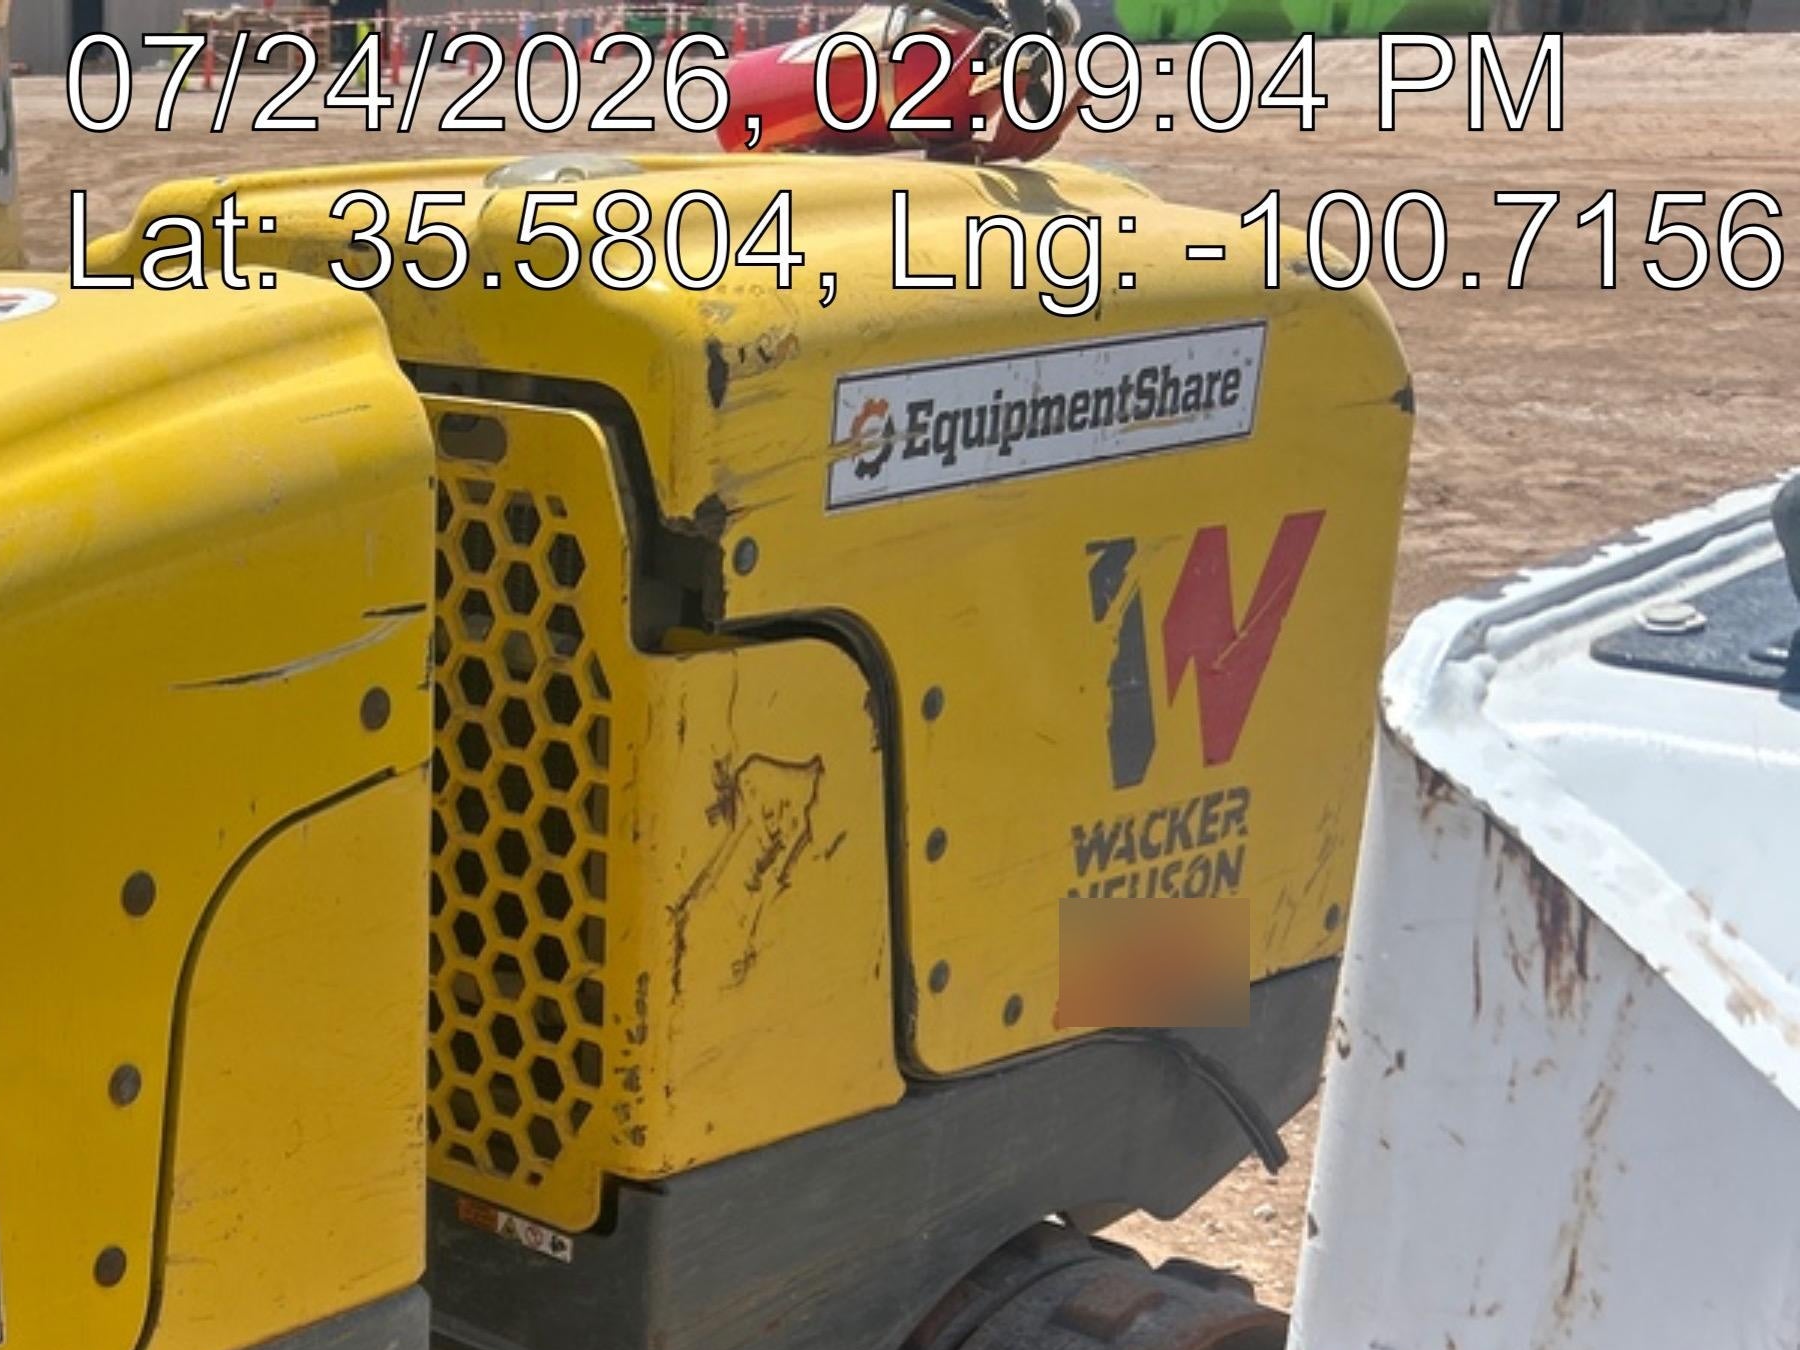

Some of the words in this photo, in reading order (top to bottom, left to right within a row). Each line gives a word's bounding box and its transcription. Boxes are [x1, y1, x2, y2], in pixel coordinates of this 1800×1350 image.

[902, 365, 1242, 466] EquipmentShare
[1067, 844, 1247, 898] USON
[1071, 786, 1251, 877] WACKER
